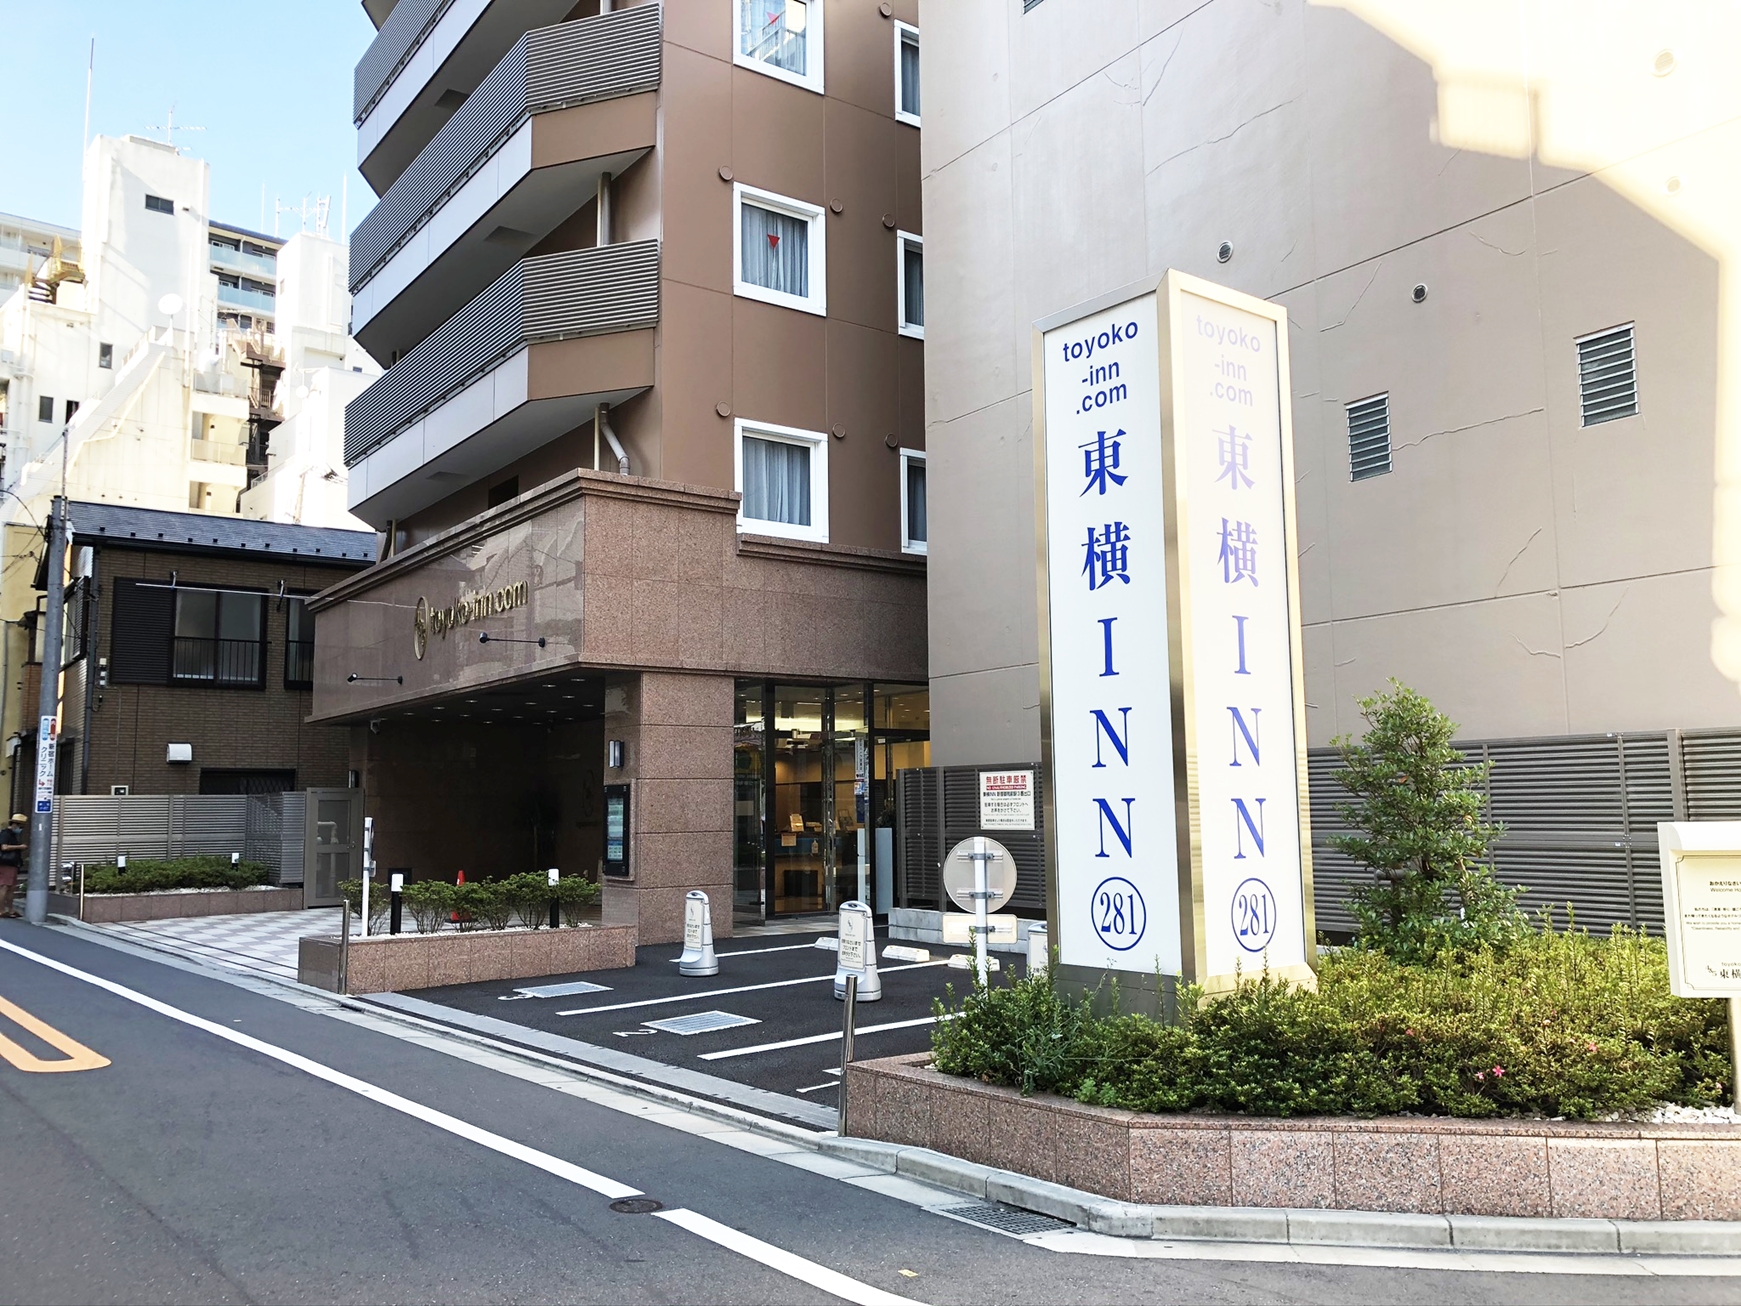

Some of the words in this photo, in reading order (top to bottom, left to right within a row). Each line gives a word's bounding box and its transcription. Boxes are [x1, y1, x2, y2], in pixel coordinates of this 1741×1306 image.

[1063, 321, 1139, 362] toyoko
[1196, 314, 1261, 353] toyoko
[1081, 361, 1121, 387] -inn
[1214, 354, 1247, 381] -inn
[1076, 383, 1128, 415] .com
[1209, 382, 1254, 407] .com
[430, 580, 529, 640] toyoko-inn.com
[1078, 428, 1136, 859] 東横INN
[1211, 424, 1267, 859] 東横INN
[39, 746, 47, 777] クリニック
[986, 775, 1026, 784] 無断駐車厳禁
[1100, 891, 1138, 936] 281
[1238, 893, 1270, 936] 281
